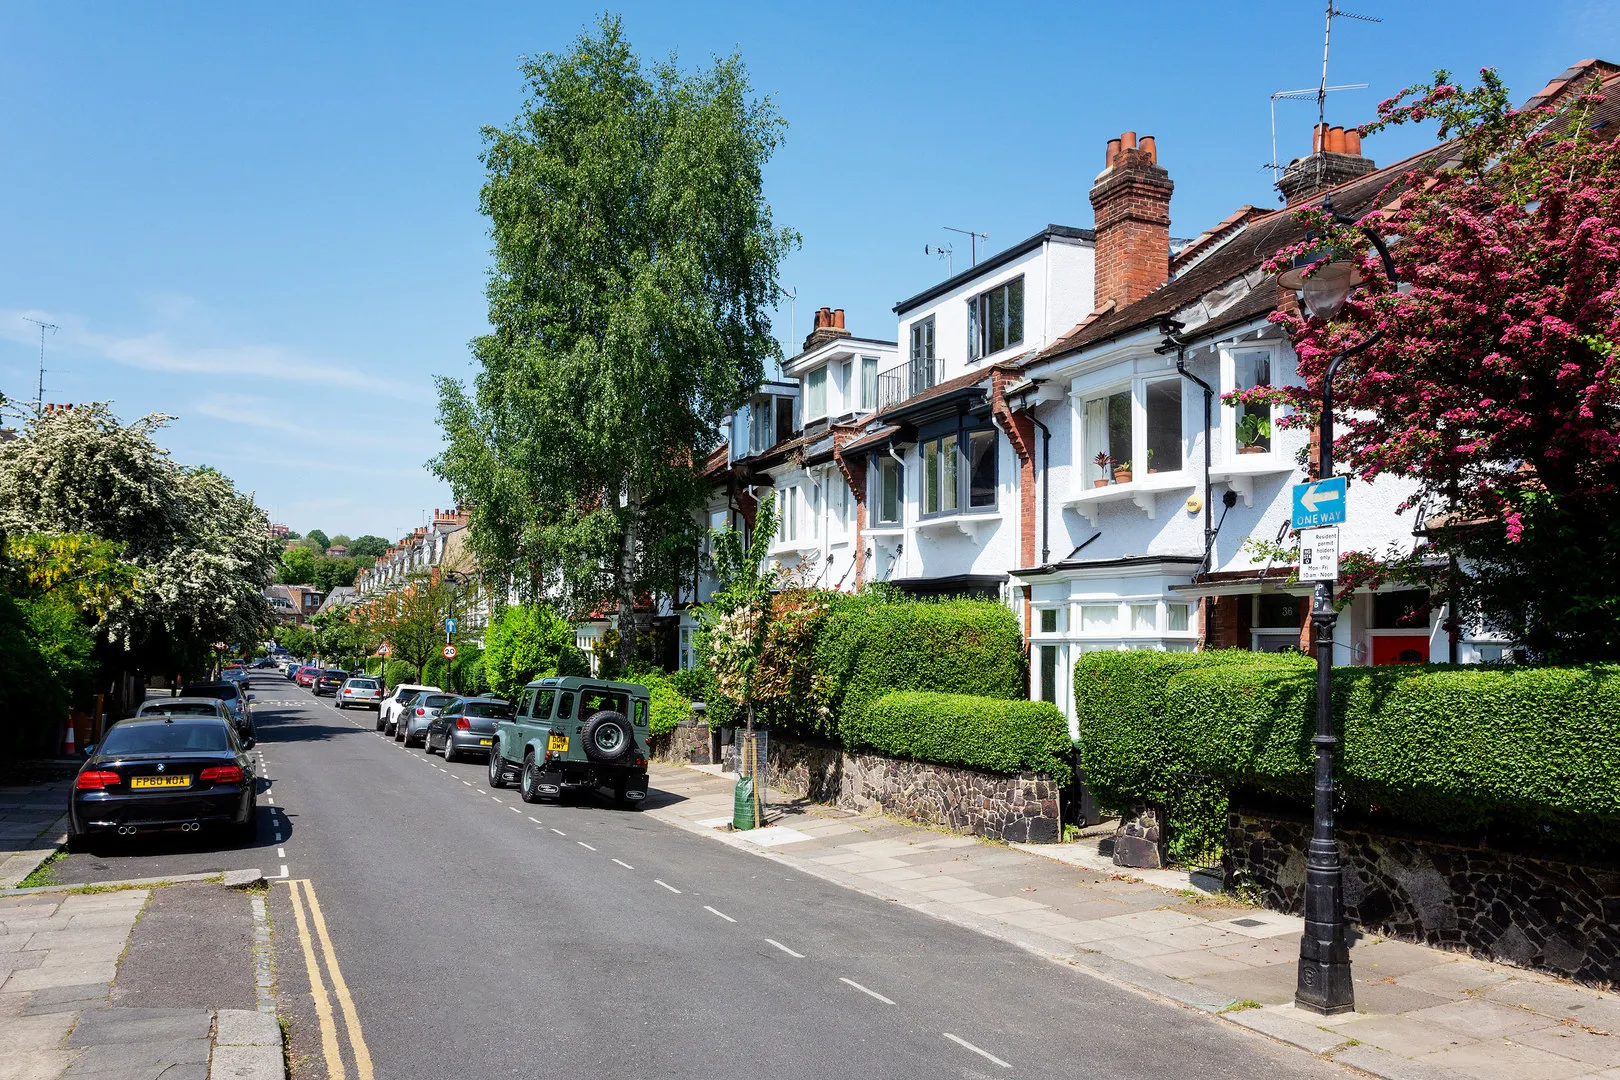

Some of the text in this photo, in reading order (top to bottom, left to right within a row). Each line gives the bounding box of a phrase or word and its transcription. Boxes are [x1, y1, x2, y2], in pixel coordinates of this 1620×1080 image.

[1297, 511, 1341, 525] ONE WAY
[1282, 606, 1293, 616] 36
[136, 776, 184, 786] FP60 WOA
